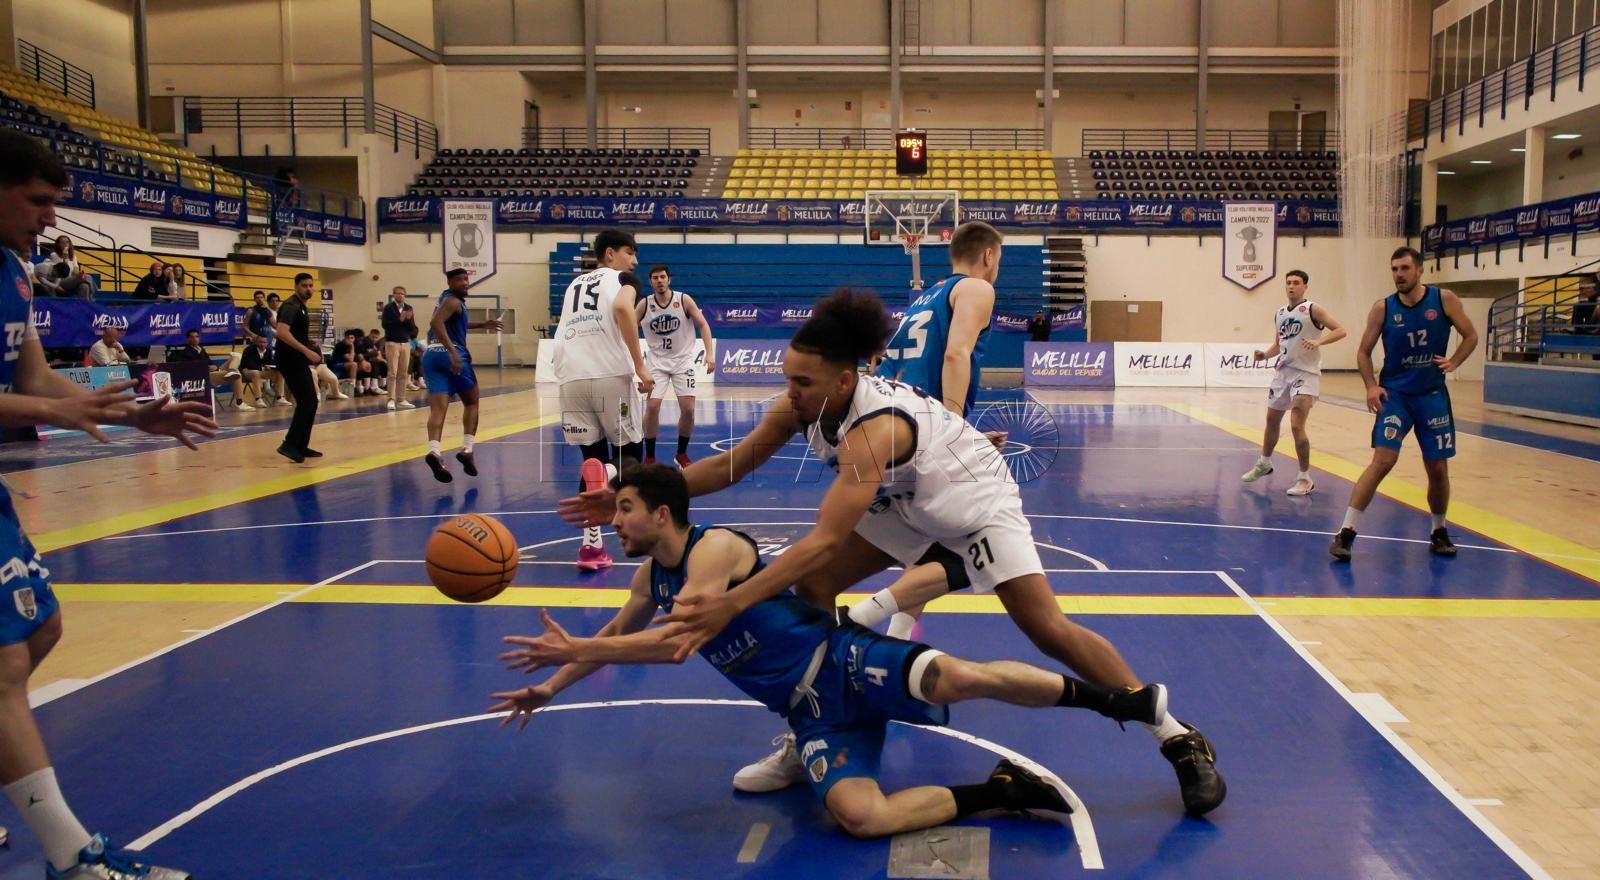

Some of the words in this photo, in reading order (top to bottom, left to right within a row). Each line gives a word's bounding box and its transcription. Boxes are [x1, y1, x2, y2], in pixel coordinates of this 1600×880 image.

[912, 147, 920, 158] 6
[98, 190, 128, 206] MELILLA
[134, 186, 165, 203] MELILLA
[184, 204, 211, 217] MELILLA
[215, 199, 241, 215] MELILLA
[389, 200, 429, 213] MELILLA
[500, 201, 542, 213] MELILLA
[612, 202, 655, 214] MELILLA
[725, 203, 768, 214] MELILLA
[1014, 203, 1057, 216] MELILLA
[1129, 204, 1172, 216] MELILLA
[568, 210, 605, 219] MELILLA
[680, 210, 719, 219] MELILLA
[794, 210, 832, 219] MELILLA
[969, 211, 1007, 220] MELILLA
[1083, 211, 1121, 221] MELILLA
[1199, 212, 1223, 221] MELIL
[1231, 215, 1255, 223] CAMPEÓN
[1314, 212, 1340, 221] MELIL
[1517, 208, 1539, 225] MELILLA
[1550, 214, 1571, 227] MELILLA
[1496, 224, 1514, 235] MELILLA
[573, 280, 601, 313] 15
[202, 312, 228, 326] MELILLA
[727, 309, 758, 318] MELILLA
[781, 309, 813, 318] MELILLA
[997, 315, 1028, 325] MELILLA
[1052, 310, 1082, 322] MELILLA
[92, 313, 128, 329] MELILLA
[150, 313, 180, 328] MELILLA
[651, 318, 680, 333] SALUD
[662, 338, 673, 350] 12
[1407, 329, 1428, 348] 12
[723, 348, 784, 366] MELILL
[1032, 350, 1106, 368] MELILLA
[1129, 354, 1192, 369] MELILLA
[69, 371, 91, 384] CLUB
[686, 379, 695, 388] 12
[181, 378, 206, 393] MELILLA
[1436, 432, 1453, 450] 12
[968, 536, 995, 571] 21
